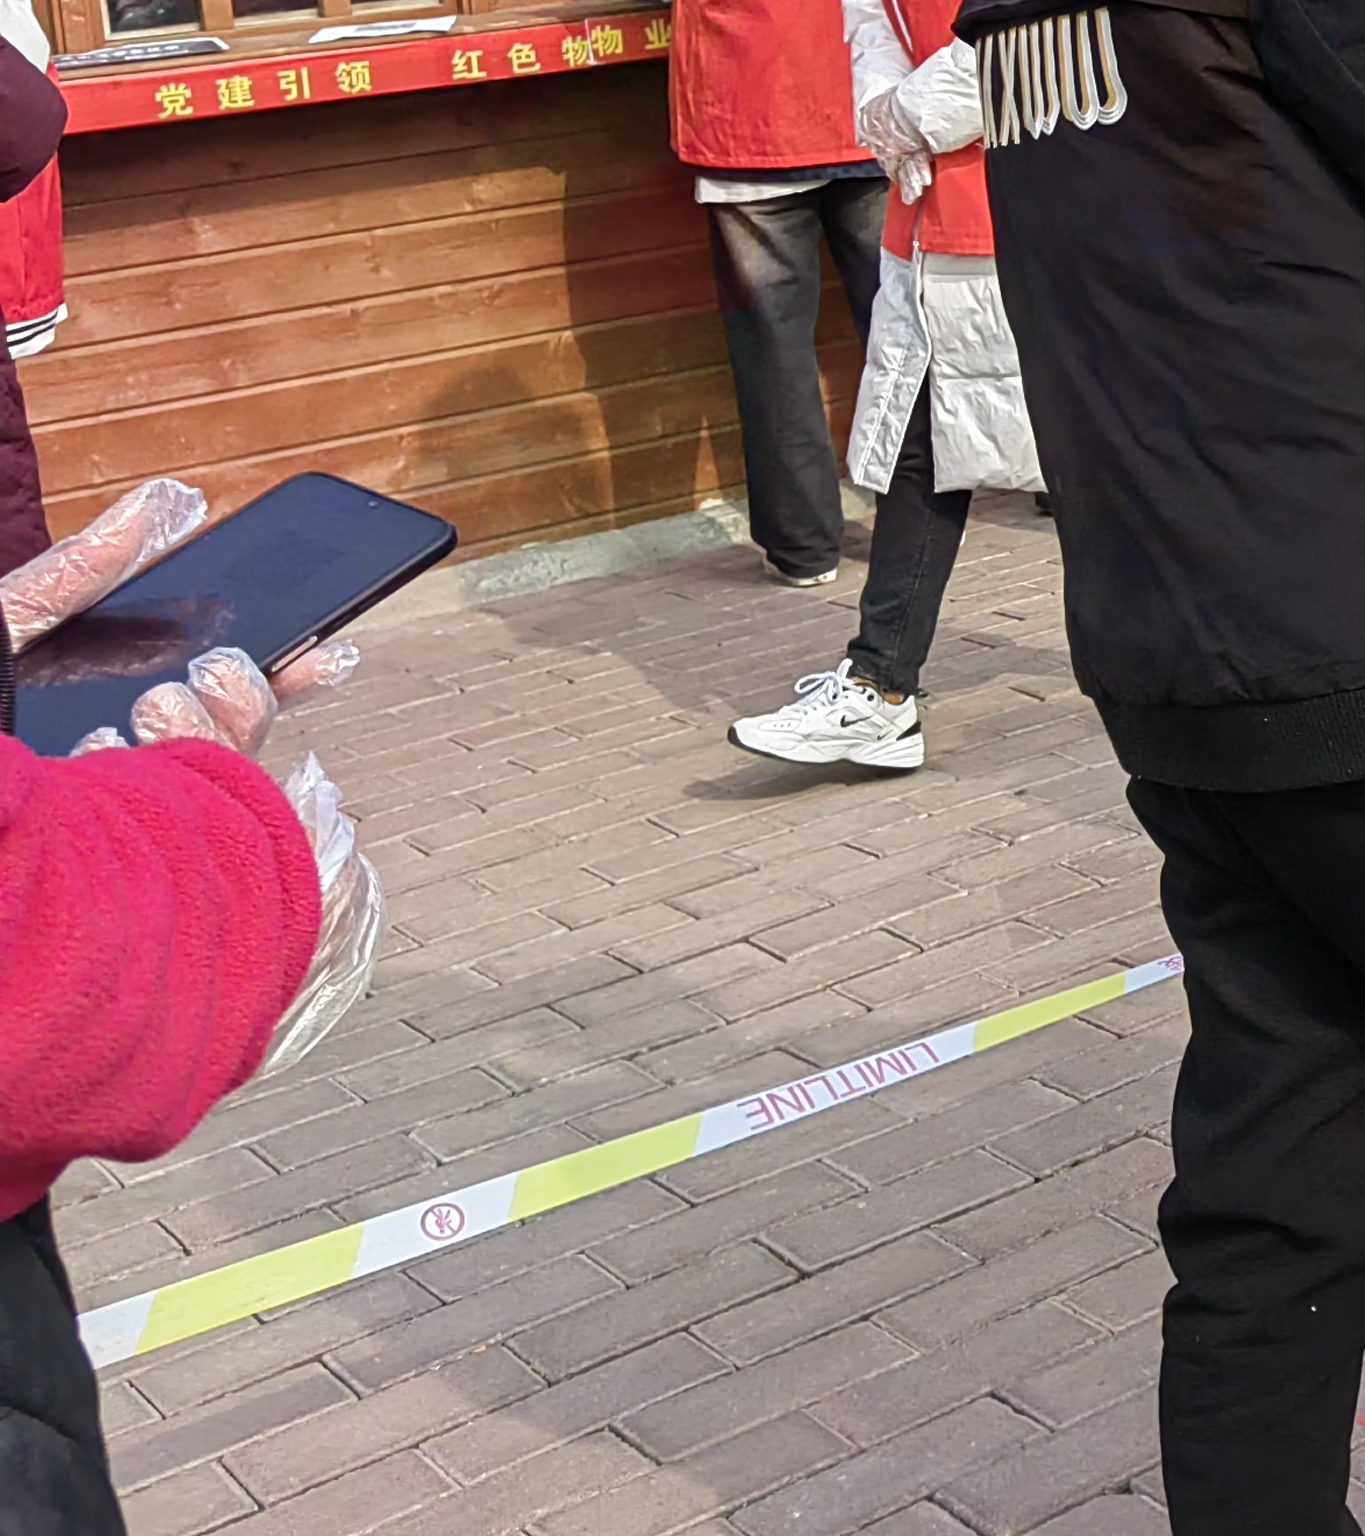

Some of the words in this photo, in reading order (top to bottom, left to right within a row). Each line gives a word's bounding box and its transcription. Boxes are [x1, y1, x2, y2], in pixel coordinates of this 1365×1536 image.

[155, 61, 373, 119] 党建引领
[736, 1041, 940, 1131] LIMITLINE
